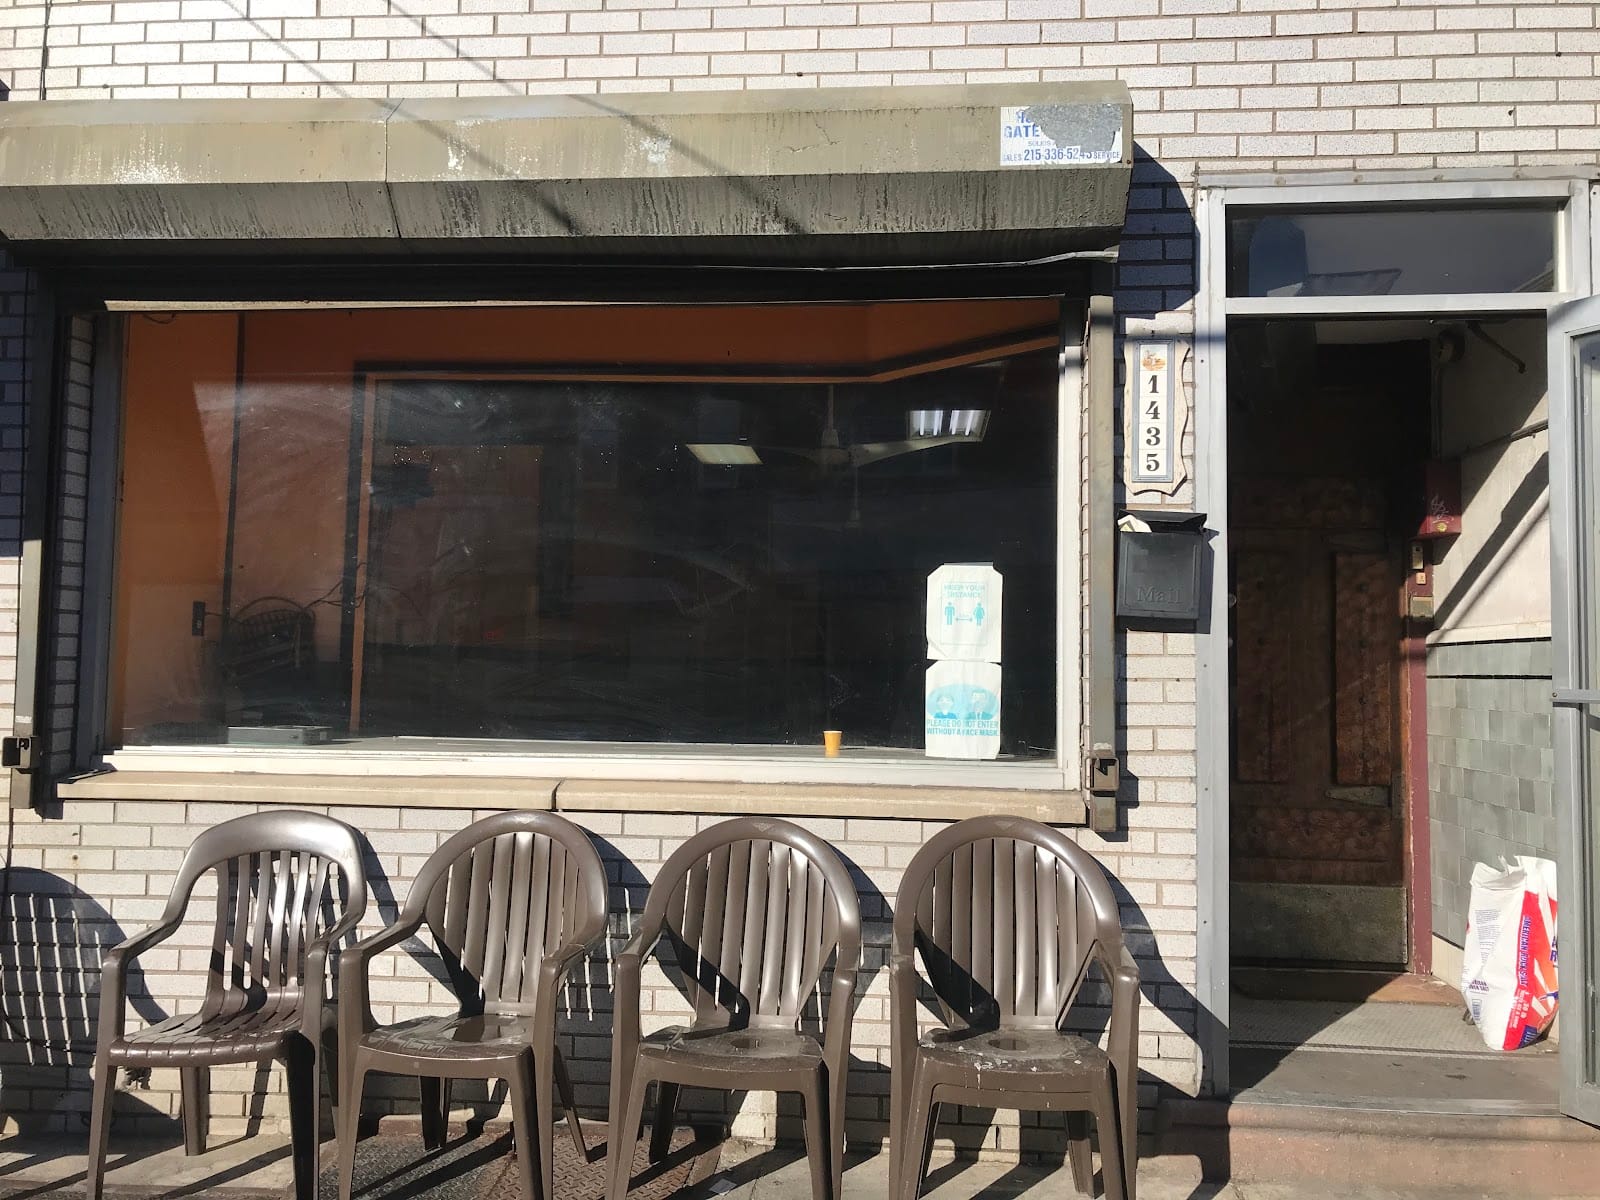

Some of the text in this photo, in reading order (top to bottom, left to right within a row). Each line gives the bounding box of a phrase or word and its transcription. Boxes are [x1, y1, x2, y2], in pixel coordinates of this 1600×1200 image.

[1145, 374, 1161, 472] 1435
[1136, 584, 1185, 604] Mail
[927, 719, 951, 727] PLEASE
[952, 720, 962, 728] DO
[977, 720, 999, 729] ENTER
